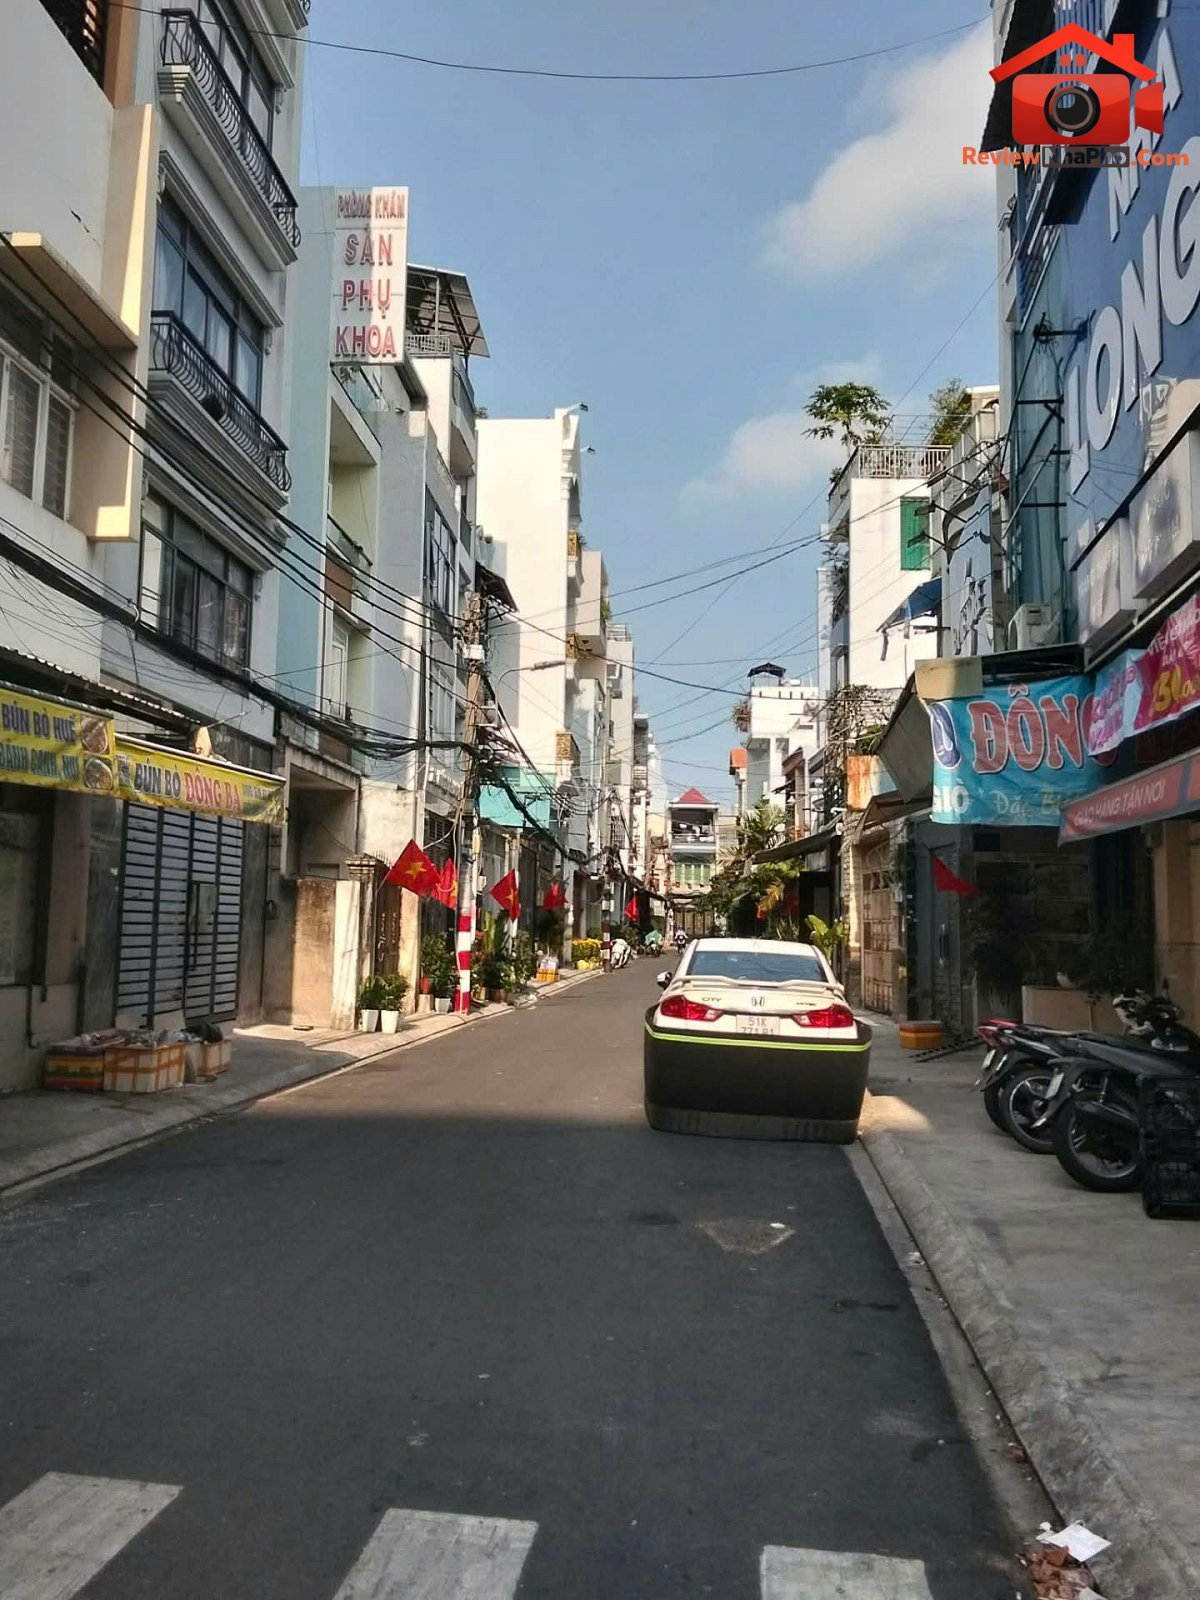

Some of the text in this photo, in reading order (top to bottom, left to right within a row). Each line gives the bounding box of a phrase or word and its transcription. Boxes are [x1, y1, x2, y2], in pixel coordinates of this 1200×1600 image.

[342, 279, 391, 320] PHỤ
[335, 324, 397, 358] KHOA
[2, 701, 77, 745] BÚN BÒ HUẾ
[134, 758, 162, 796] BÚN
[163, 764, 181, 800] BÒ
[183, 766, 221, 808] ĐÔNG
[224, 779, 241, 814] BA
